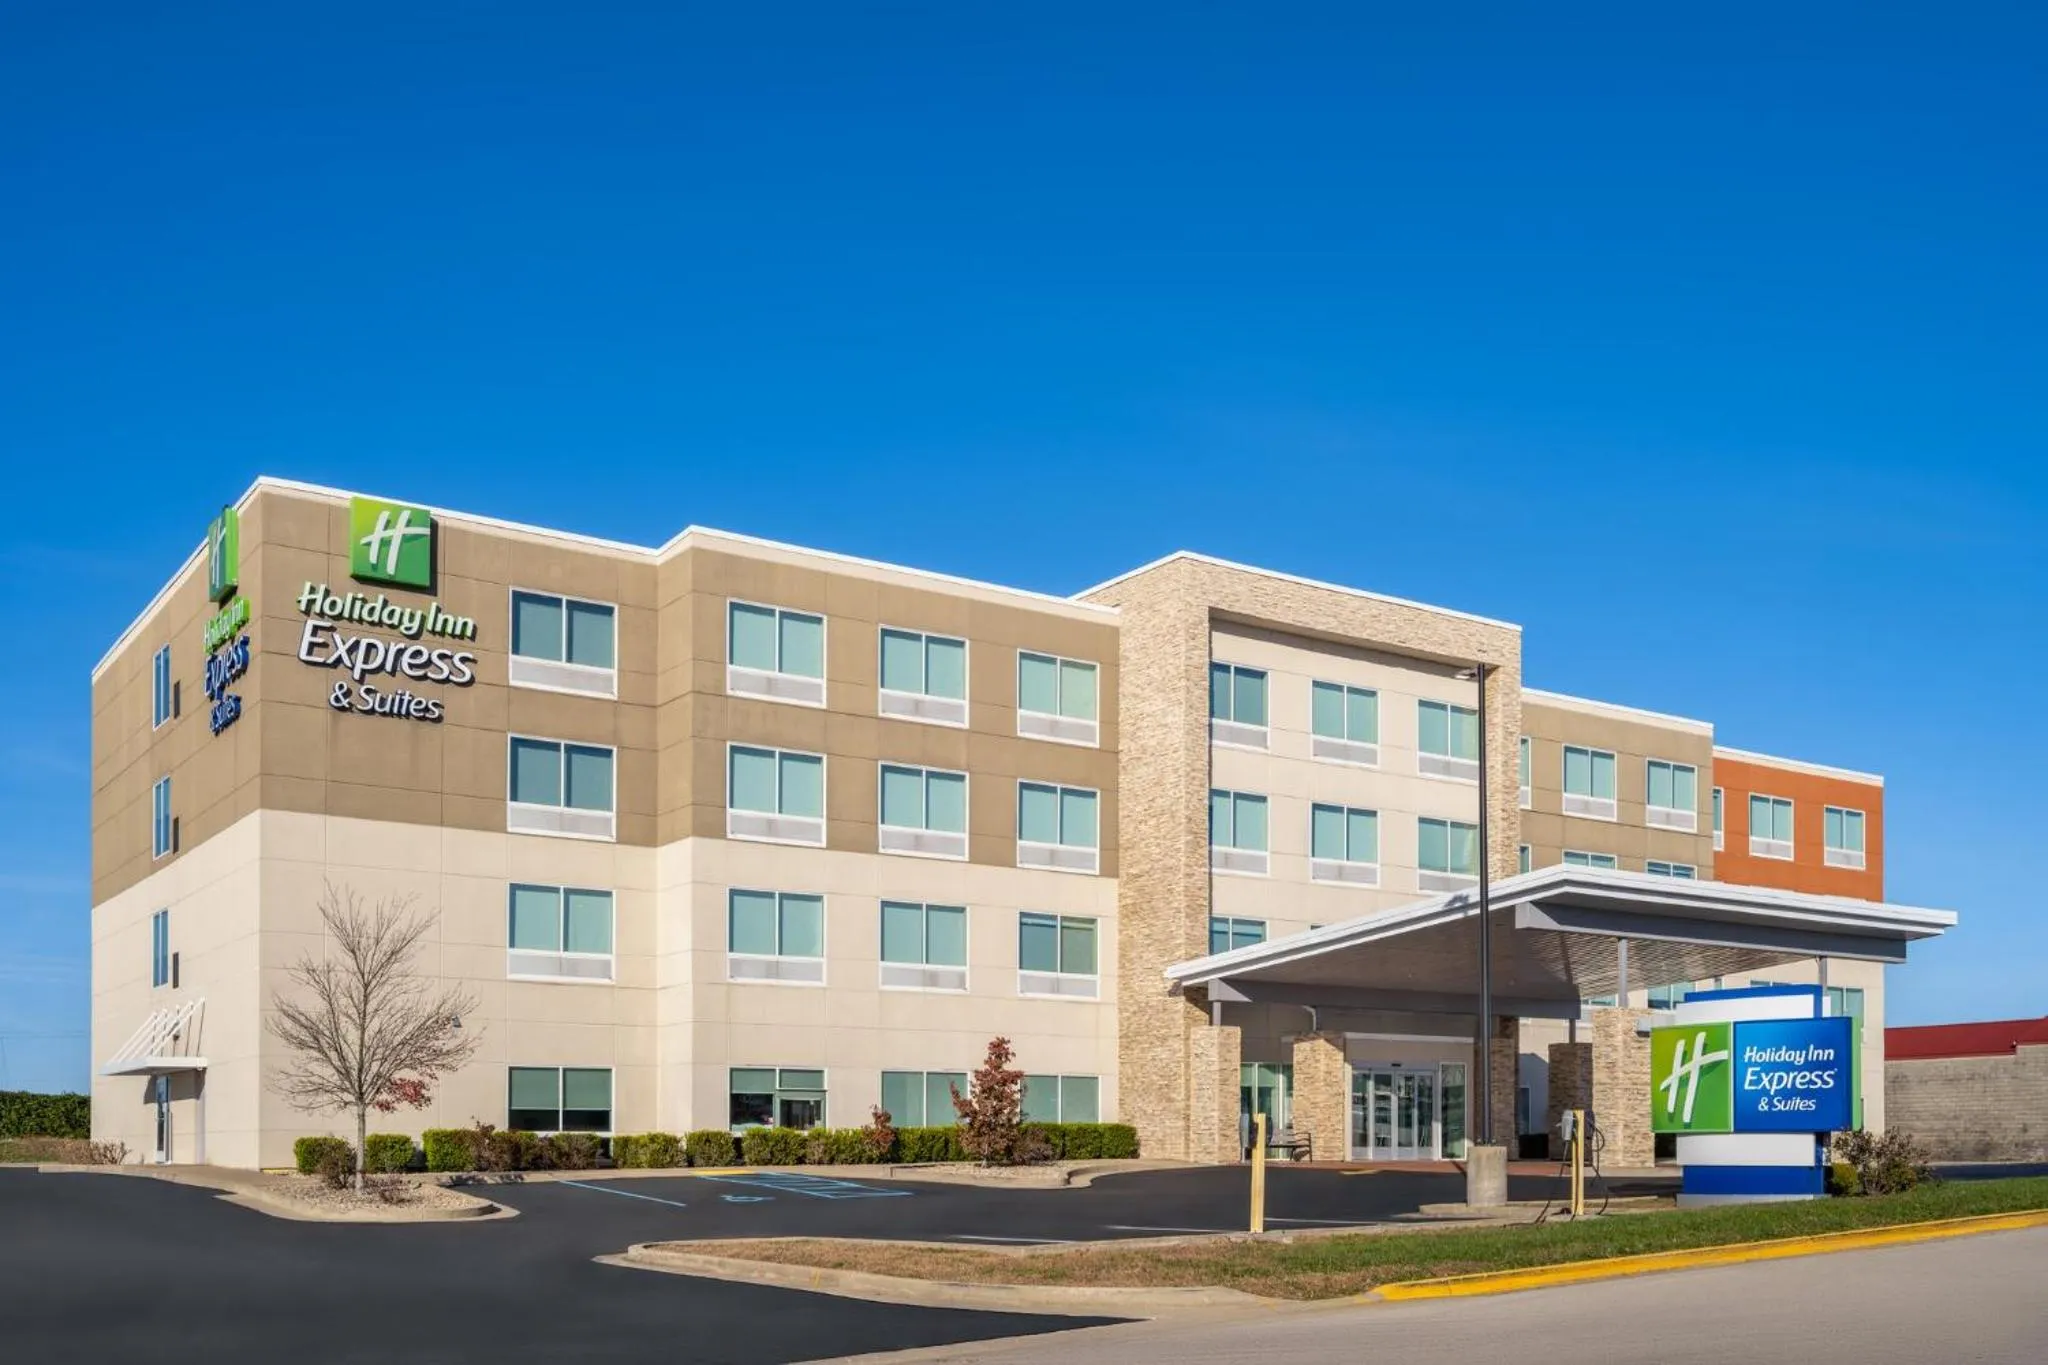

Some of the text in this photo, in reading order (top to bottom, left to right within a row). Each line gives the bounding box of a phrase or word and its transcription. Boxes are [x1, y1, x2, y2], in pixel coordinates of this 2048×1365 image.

[298, 582, 474, 637] Holiday Inn
[204, 635, 247, 699] Express
[299, 619, 475, 682] Express
[330, 681, 442, 719] & Suites
[1744, 1044, 1834, 1065] Holiday Inn
[1744, 1067, 1836, 1095] Express
[1758, 1096, 1816, 1111] & Suites
